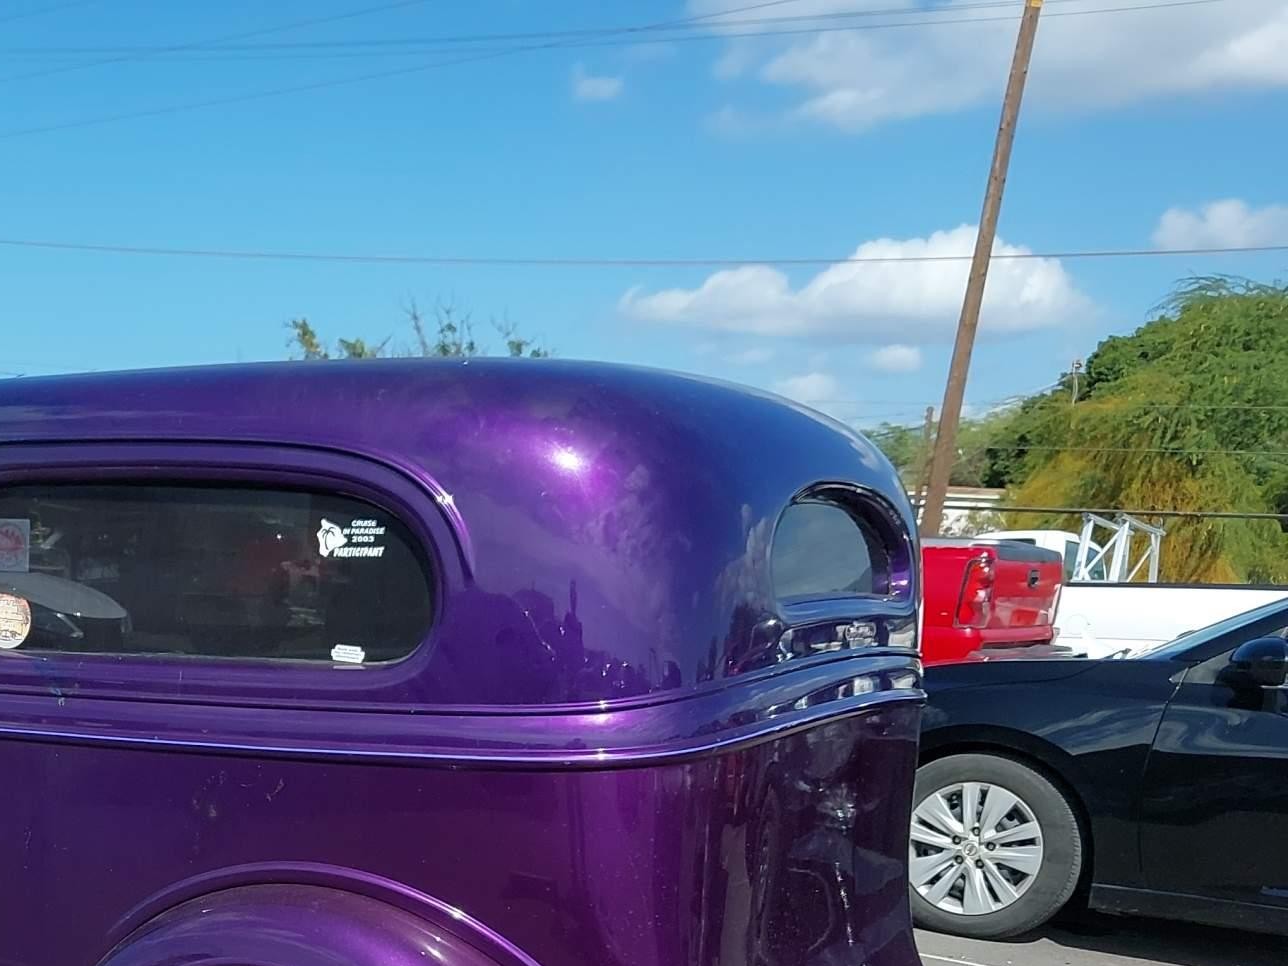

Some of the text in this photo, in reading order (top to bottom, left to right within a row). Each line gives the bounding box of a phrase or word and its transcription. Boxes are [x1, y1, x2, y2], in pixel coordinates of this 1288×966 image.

[351, 519, 377, 527] CRUISE
[351, 526, 385, 535] PARADISE
[333, 546, 385, 557] PARTICIPANT
